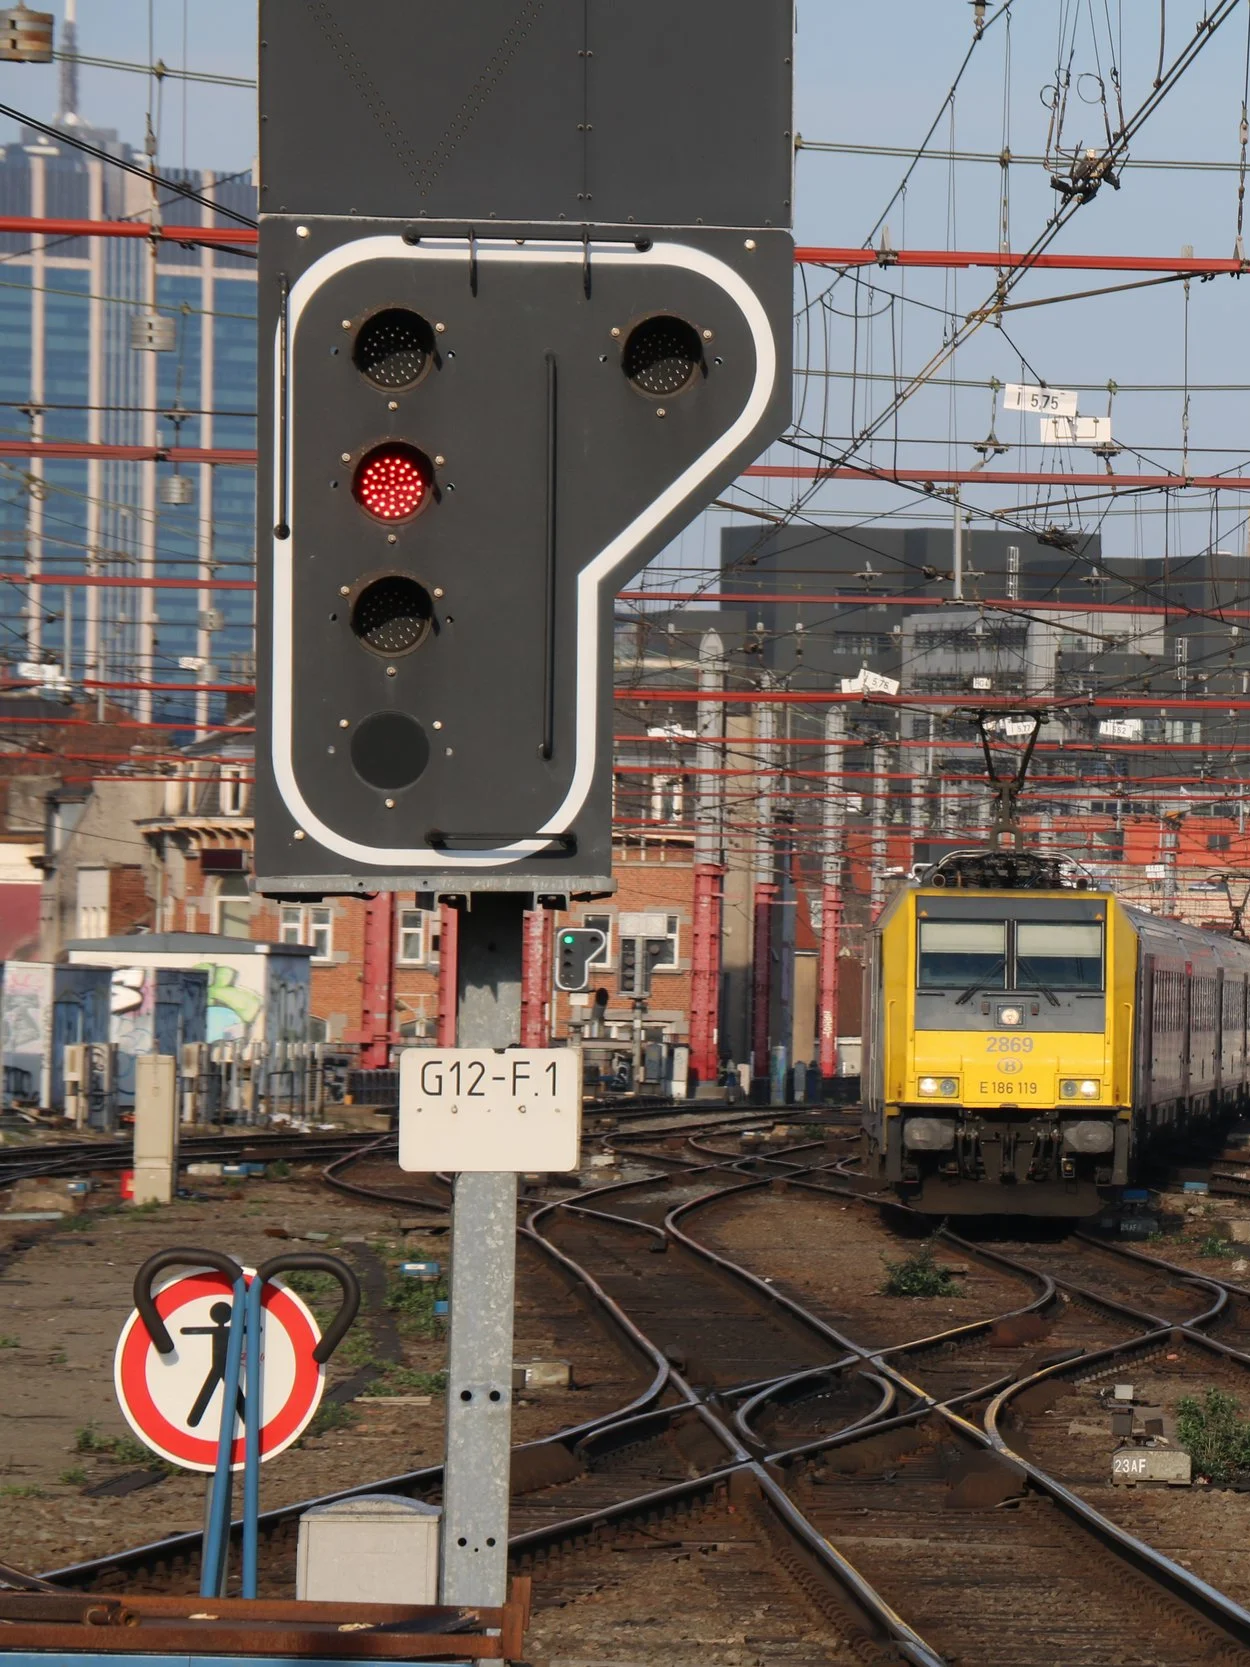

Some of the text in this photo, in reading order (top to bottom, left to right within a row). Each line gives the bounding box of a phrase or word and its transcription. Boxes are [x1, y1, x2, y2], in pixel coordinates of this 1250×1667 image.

[986, 1036, 1033, 1053] 2869
[421, 1060, 557, 1097] G12-F.1
[979, 1081, 1037, 1095] E 186 119
[1114, 1459, 1147, 1473] 23AF
